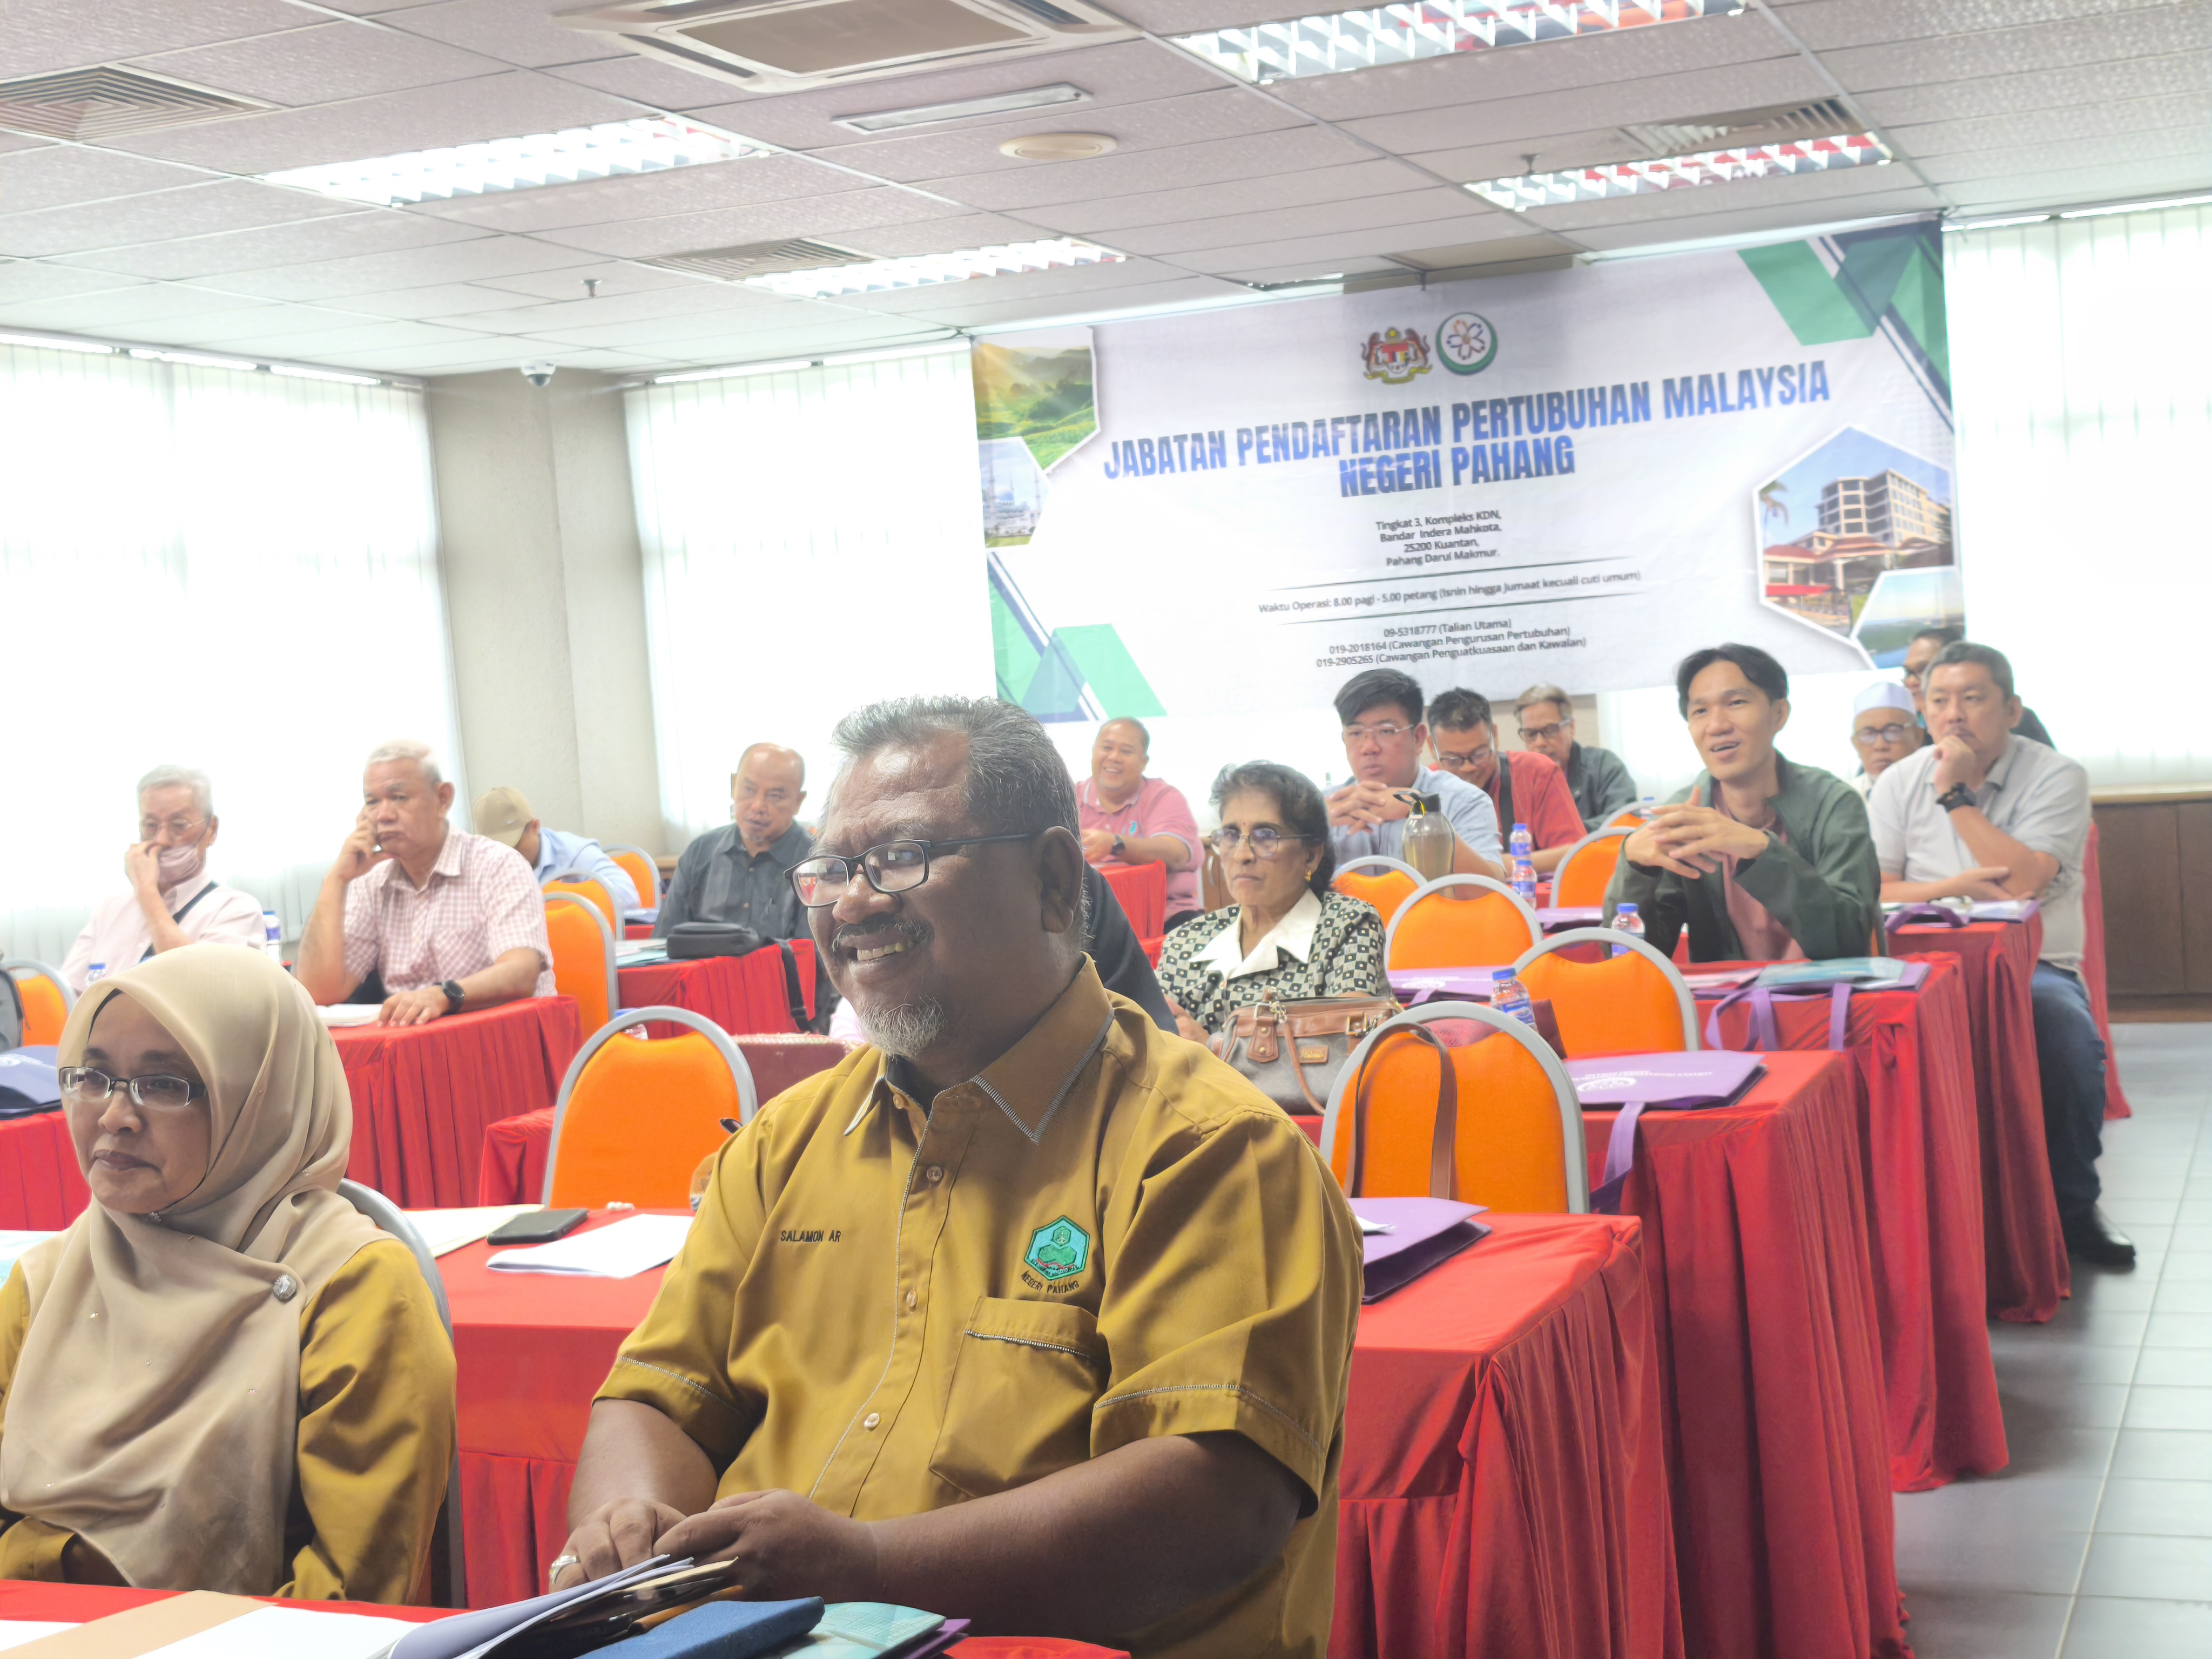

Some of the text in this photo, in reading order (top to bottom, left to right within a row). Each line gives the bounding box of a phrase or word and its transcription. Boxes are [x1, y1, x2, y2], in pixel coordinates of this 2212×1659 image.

[1103, 360, 1830, 480] JABATAN PENDAFTARAN PERTUBUHAN MALAYSIA
[1339, 435, 1575, 498] NEGERI PAHANG
[1375, 510, 1501, 531] Tingkat 3, Kompleks KDN,
[1380, 524, 1502, 542] Bandar Indera Mahkota,
[1404, 539, 1479, 552] 25200 Kuantan,
[1386, 549, 1500, 566] Pahang Darul Makmur.
[1258, 603, 1290, 613] Waktu
[1292, 598, 1331, 611] Operasi:
[1333, 597, 1352, 607] 8.00
[1354, 594, 1375, 608] pagi
[1382, 592, 1401, 603] 5.00
[1404, 590, 1438, 603] petang
[1468, 584, 1501, 596] hingga
[1503, 581, 1540, 594] Jumaat
[1543, 576, 1578, 587] kecuali
[1581, 574, 1600, 585] cuti
[1602, 571, 1641, 583] umum)
[1384, 619, 1512, 638] 09-5318777 (Talian Utama)
[1329, 626, 1570, 655] 019-2018164 (Cawangan Pengurusan Pertubuhan)
[1317, 638, 1586, 667] 019-2905265 (Cawangan Penguatkuasaan dan Kawalan)
[780, 1230, 841, 1242] SALAMON AR
[1021, 1270, 1080, 1294] NEGERI PAHANG
